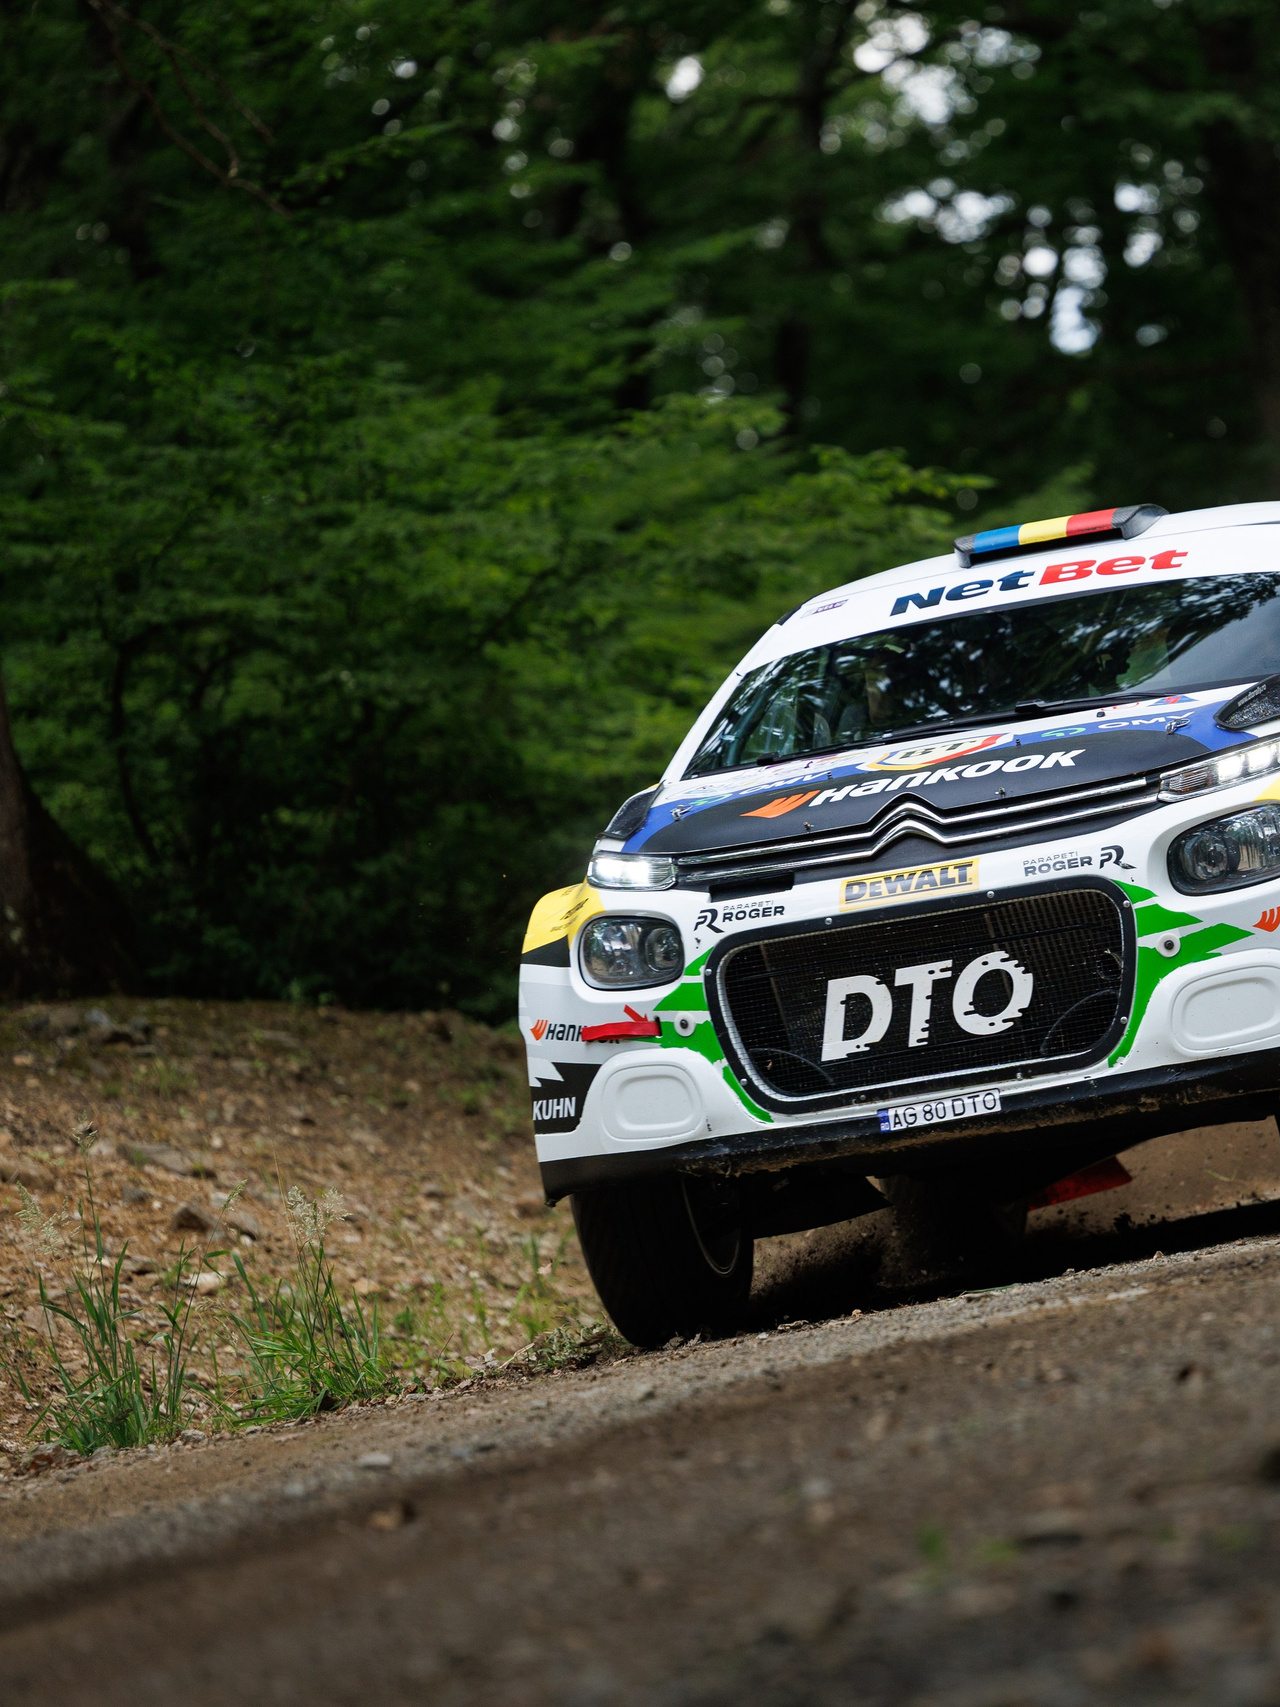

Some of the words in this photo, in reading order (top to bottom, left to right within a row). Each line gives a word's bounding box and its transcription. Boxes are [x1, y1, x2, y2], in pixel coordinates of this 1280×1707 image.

[890, 549, 1188, 617] NetBet
[1023, 851, 1079, 866] PARAPETI
[1024, 856, 1093, 876] ROGER
[845, 863, 973, 901] DEWALT
[722, 900, 774, 911] PARAPETI
[722, 905, 785, 923] ROGER
[821, 951, 1034, 1062] DTO
[532, 1096, 576, 1121] KUHN
[893, 1107, 917, 1129] AG
[922, 1101, 947, 1122] 80
[951, 1092, 997, 1117] DTO
